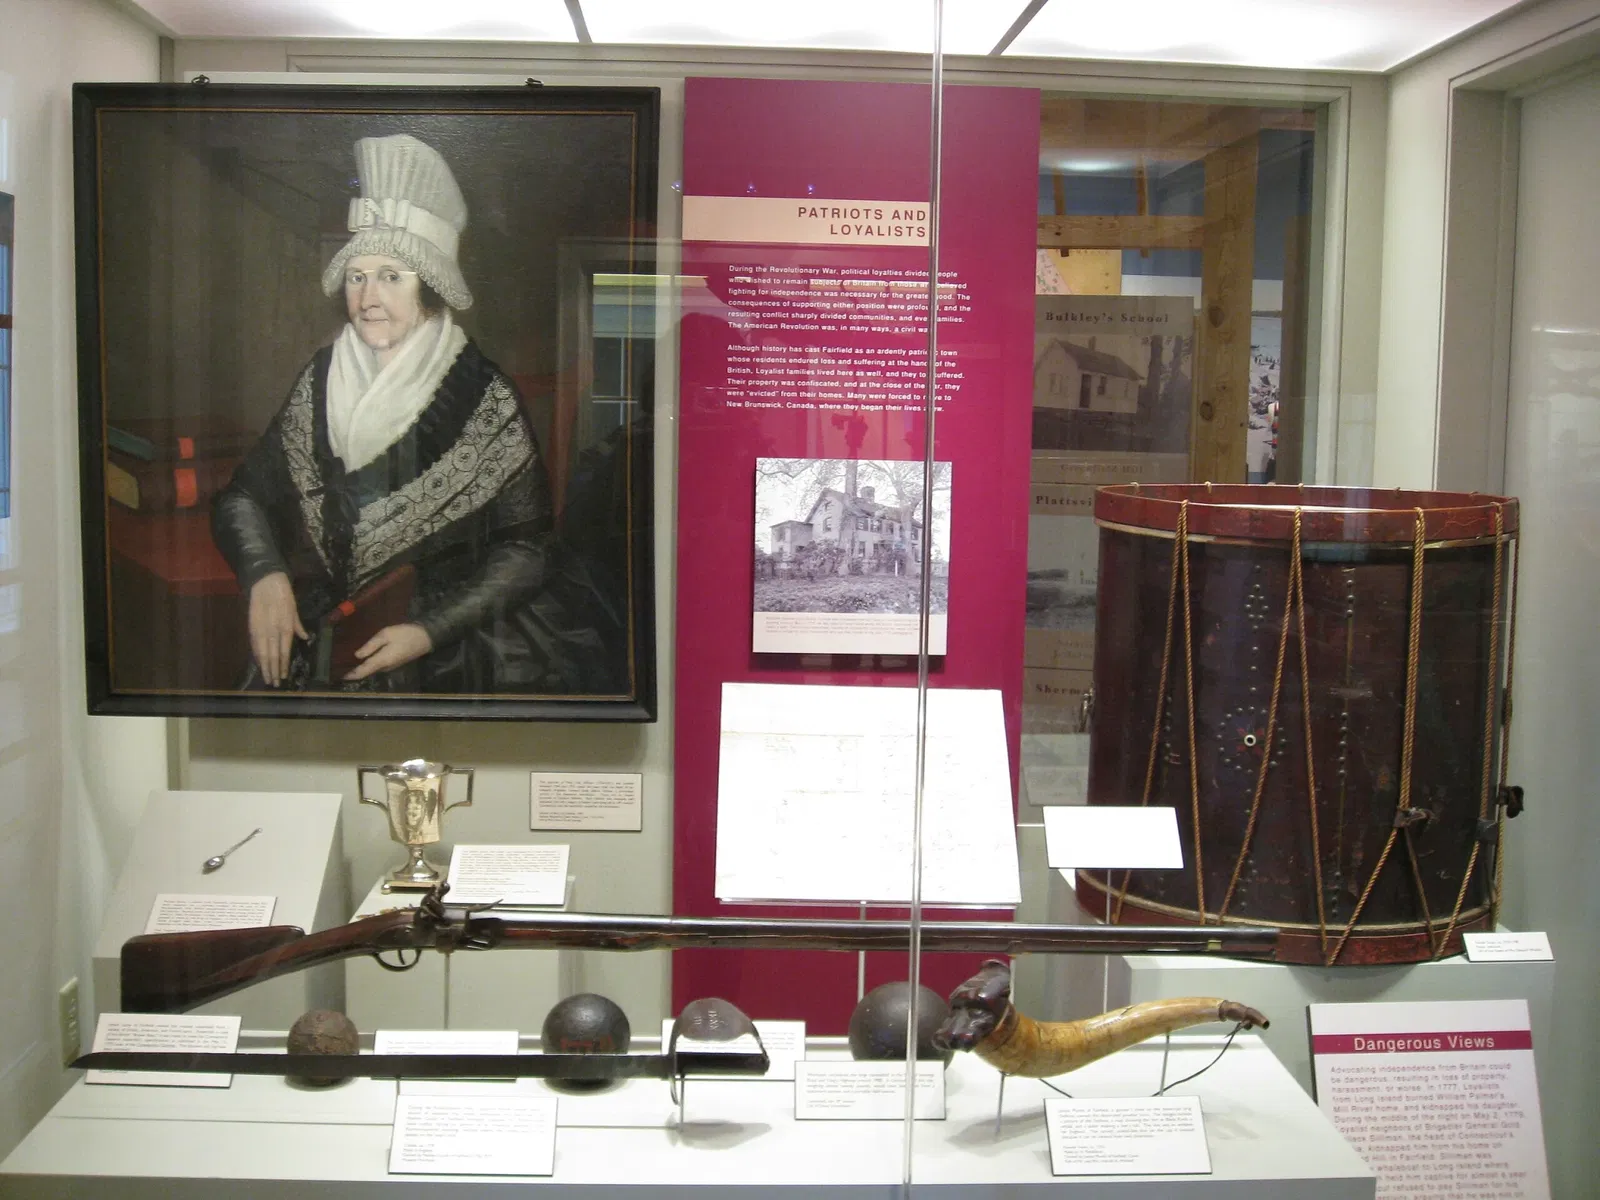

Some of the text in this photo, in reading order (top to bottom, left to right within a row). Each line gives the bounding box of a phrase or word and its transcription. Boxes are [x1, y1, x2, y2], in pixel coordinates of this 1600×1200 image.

[798, 207, 926, 221] PATRIOTS AND
[830, 224, 926, 238] LOYALISTS
[729, 265, 753, 274] During
[770, 266, 819, 275] Revolutionary
[841, 268, 870, 277] political
[872, 268, 902, 277] loyalties
[937, 270, 958, 279] eople
[728, 287, 756, 297] fighting
[771, 288, 821, 298] independence
[841, 291, 877, 300] necessary
[906, 292, 928, 301] greate
[728, 300, 780, 309] consequences
[792, 300, 830, 310] supporting
[856, 302, 885, 311] position
[728, 310, 760, 319] resulting
[791, 311, 818, 321] sharply
[1046, 312, 1168, 324] Bulkley's School
[744, 321, 778, 329] American
[781, 322, 819, 330] Revolution
[849, 325, 869, 333] many
[727, 344, 760, 353] Although
[762, 345, 787, 354] history
[877, 347, 907, 356] ardently
[854, 358, 886, 367] suffering
[756, 367, 784, 376] Loyalist
[901, 370, 917, 379] they
[748, 378, 778, 387] property
[944, 383, 960, 392] they
[746, 389, 779, 397] "evicted"
[847, 392, 866, 401] Many
[843, 403, 859, 411] they
[861, 403, 883, 412] began
[1036, 495, 1092, 507] Plattsvi
[1036, 683, 1082, 695] Sherm
[1353, 1035, 1494, 1053] Dangerous Views
